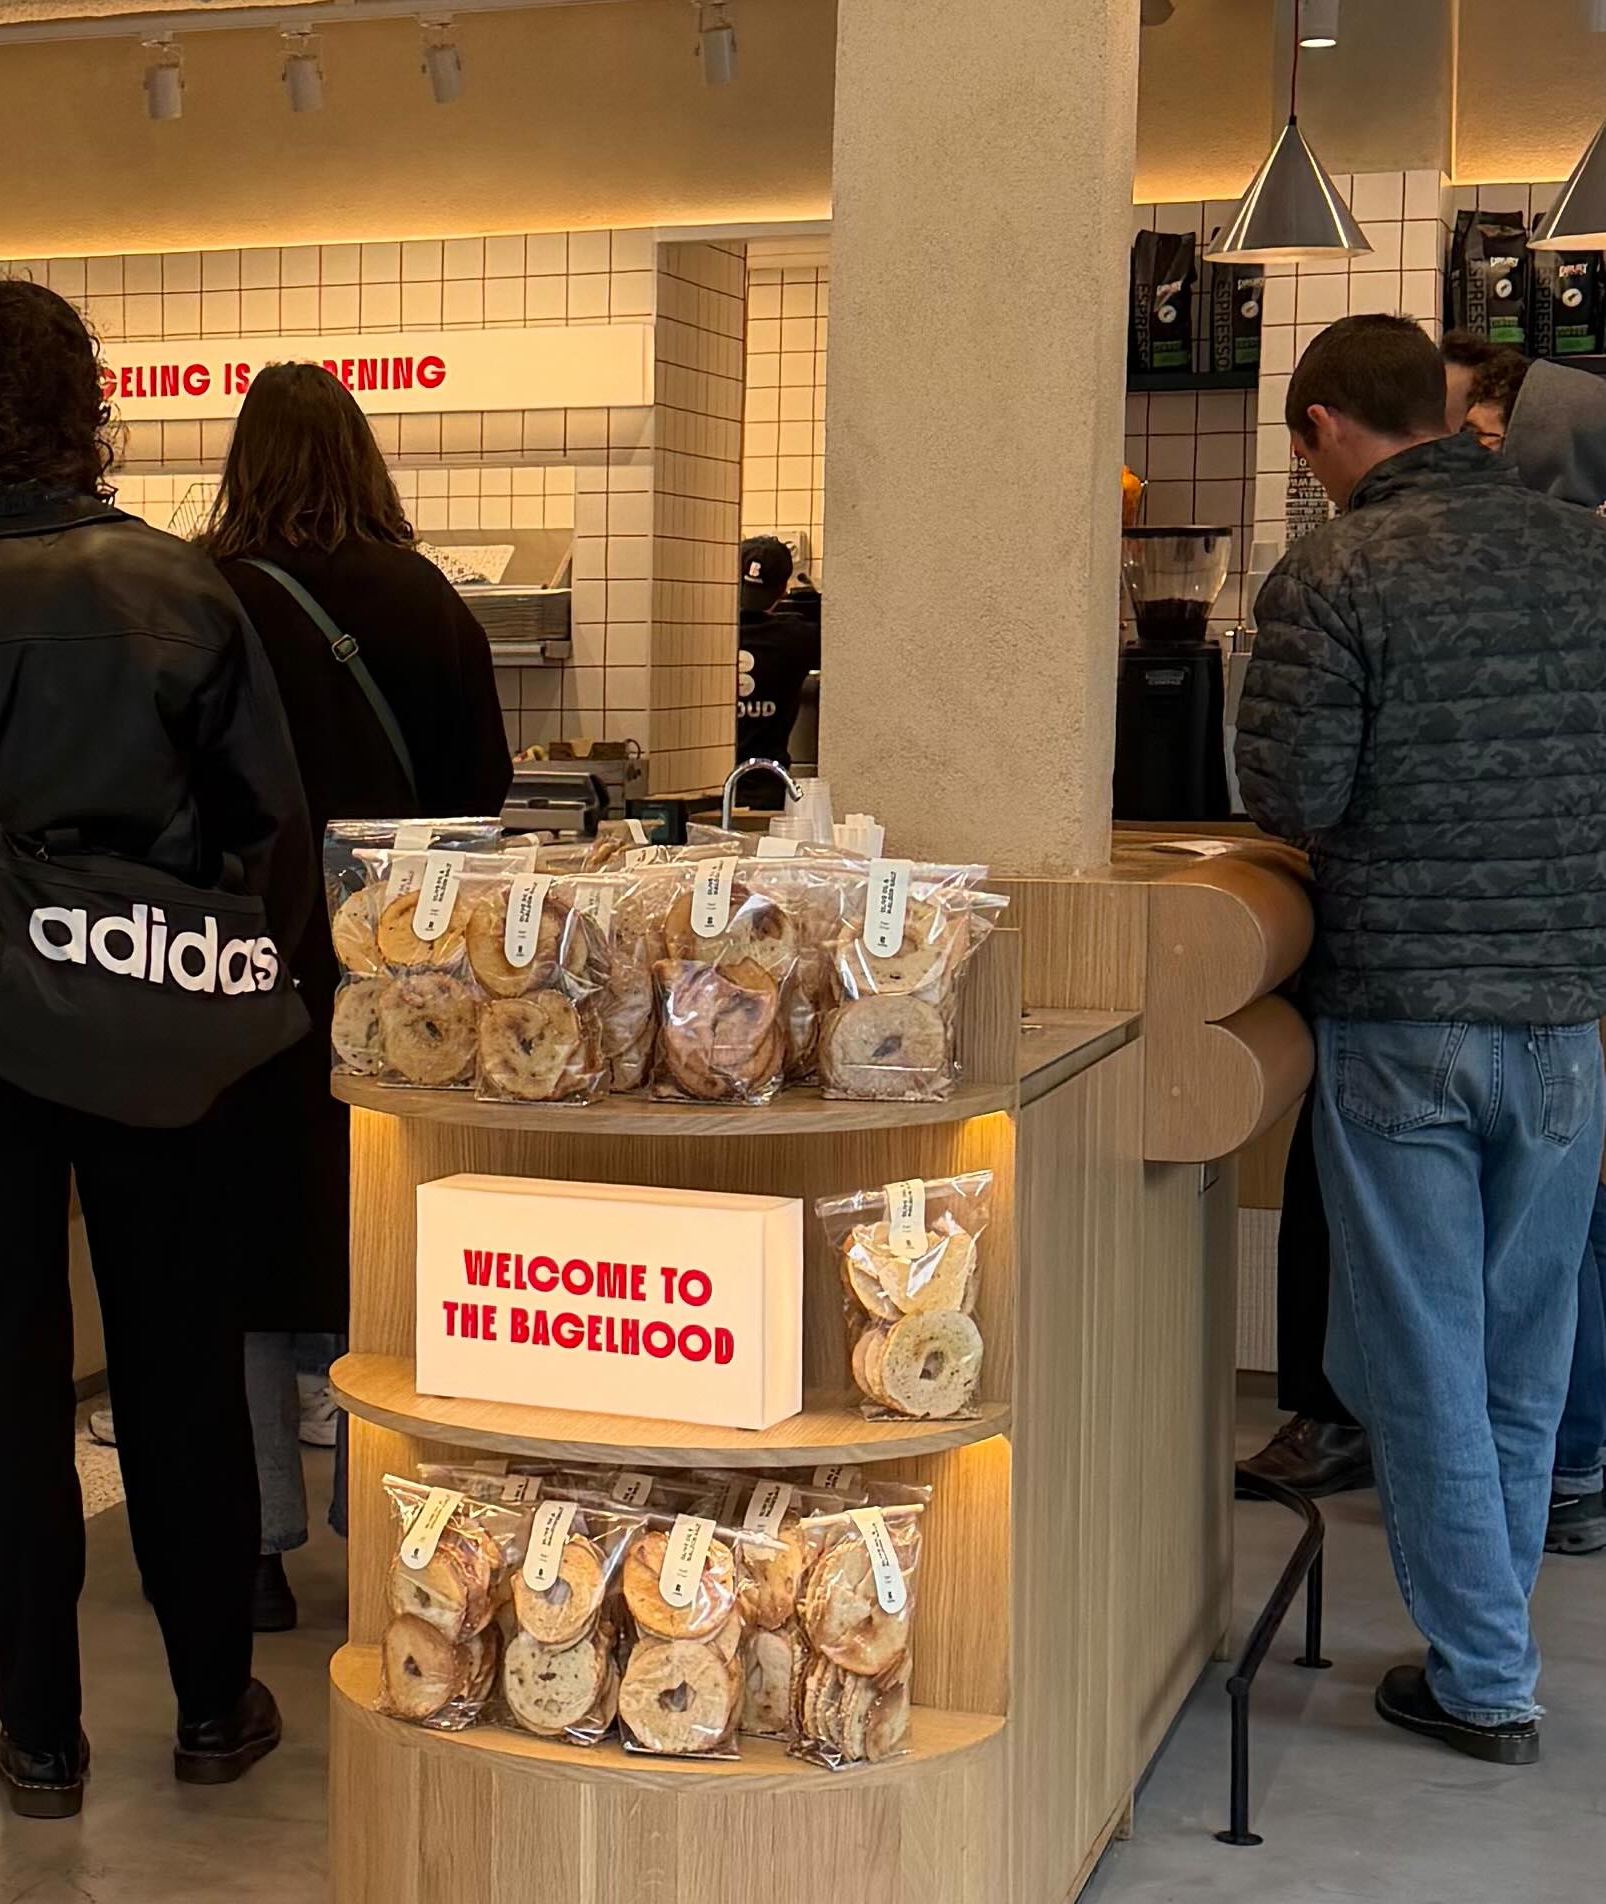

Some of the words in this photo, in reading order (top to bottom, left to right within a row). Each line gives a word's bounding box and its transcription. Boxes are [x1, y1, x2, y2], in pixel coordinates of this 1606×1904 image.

[225, 362, 251, 396] IS
[28, 903, 280, 996] adidas
[463, 1249, 647, 1302] WELCOME
[661, 1267, 712, 1307] TO
[442, 1300, 497, 1342] THE
[510, 1307, 735, 1365] BAGELHOOD
